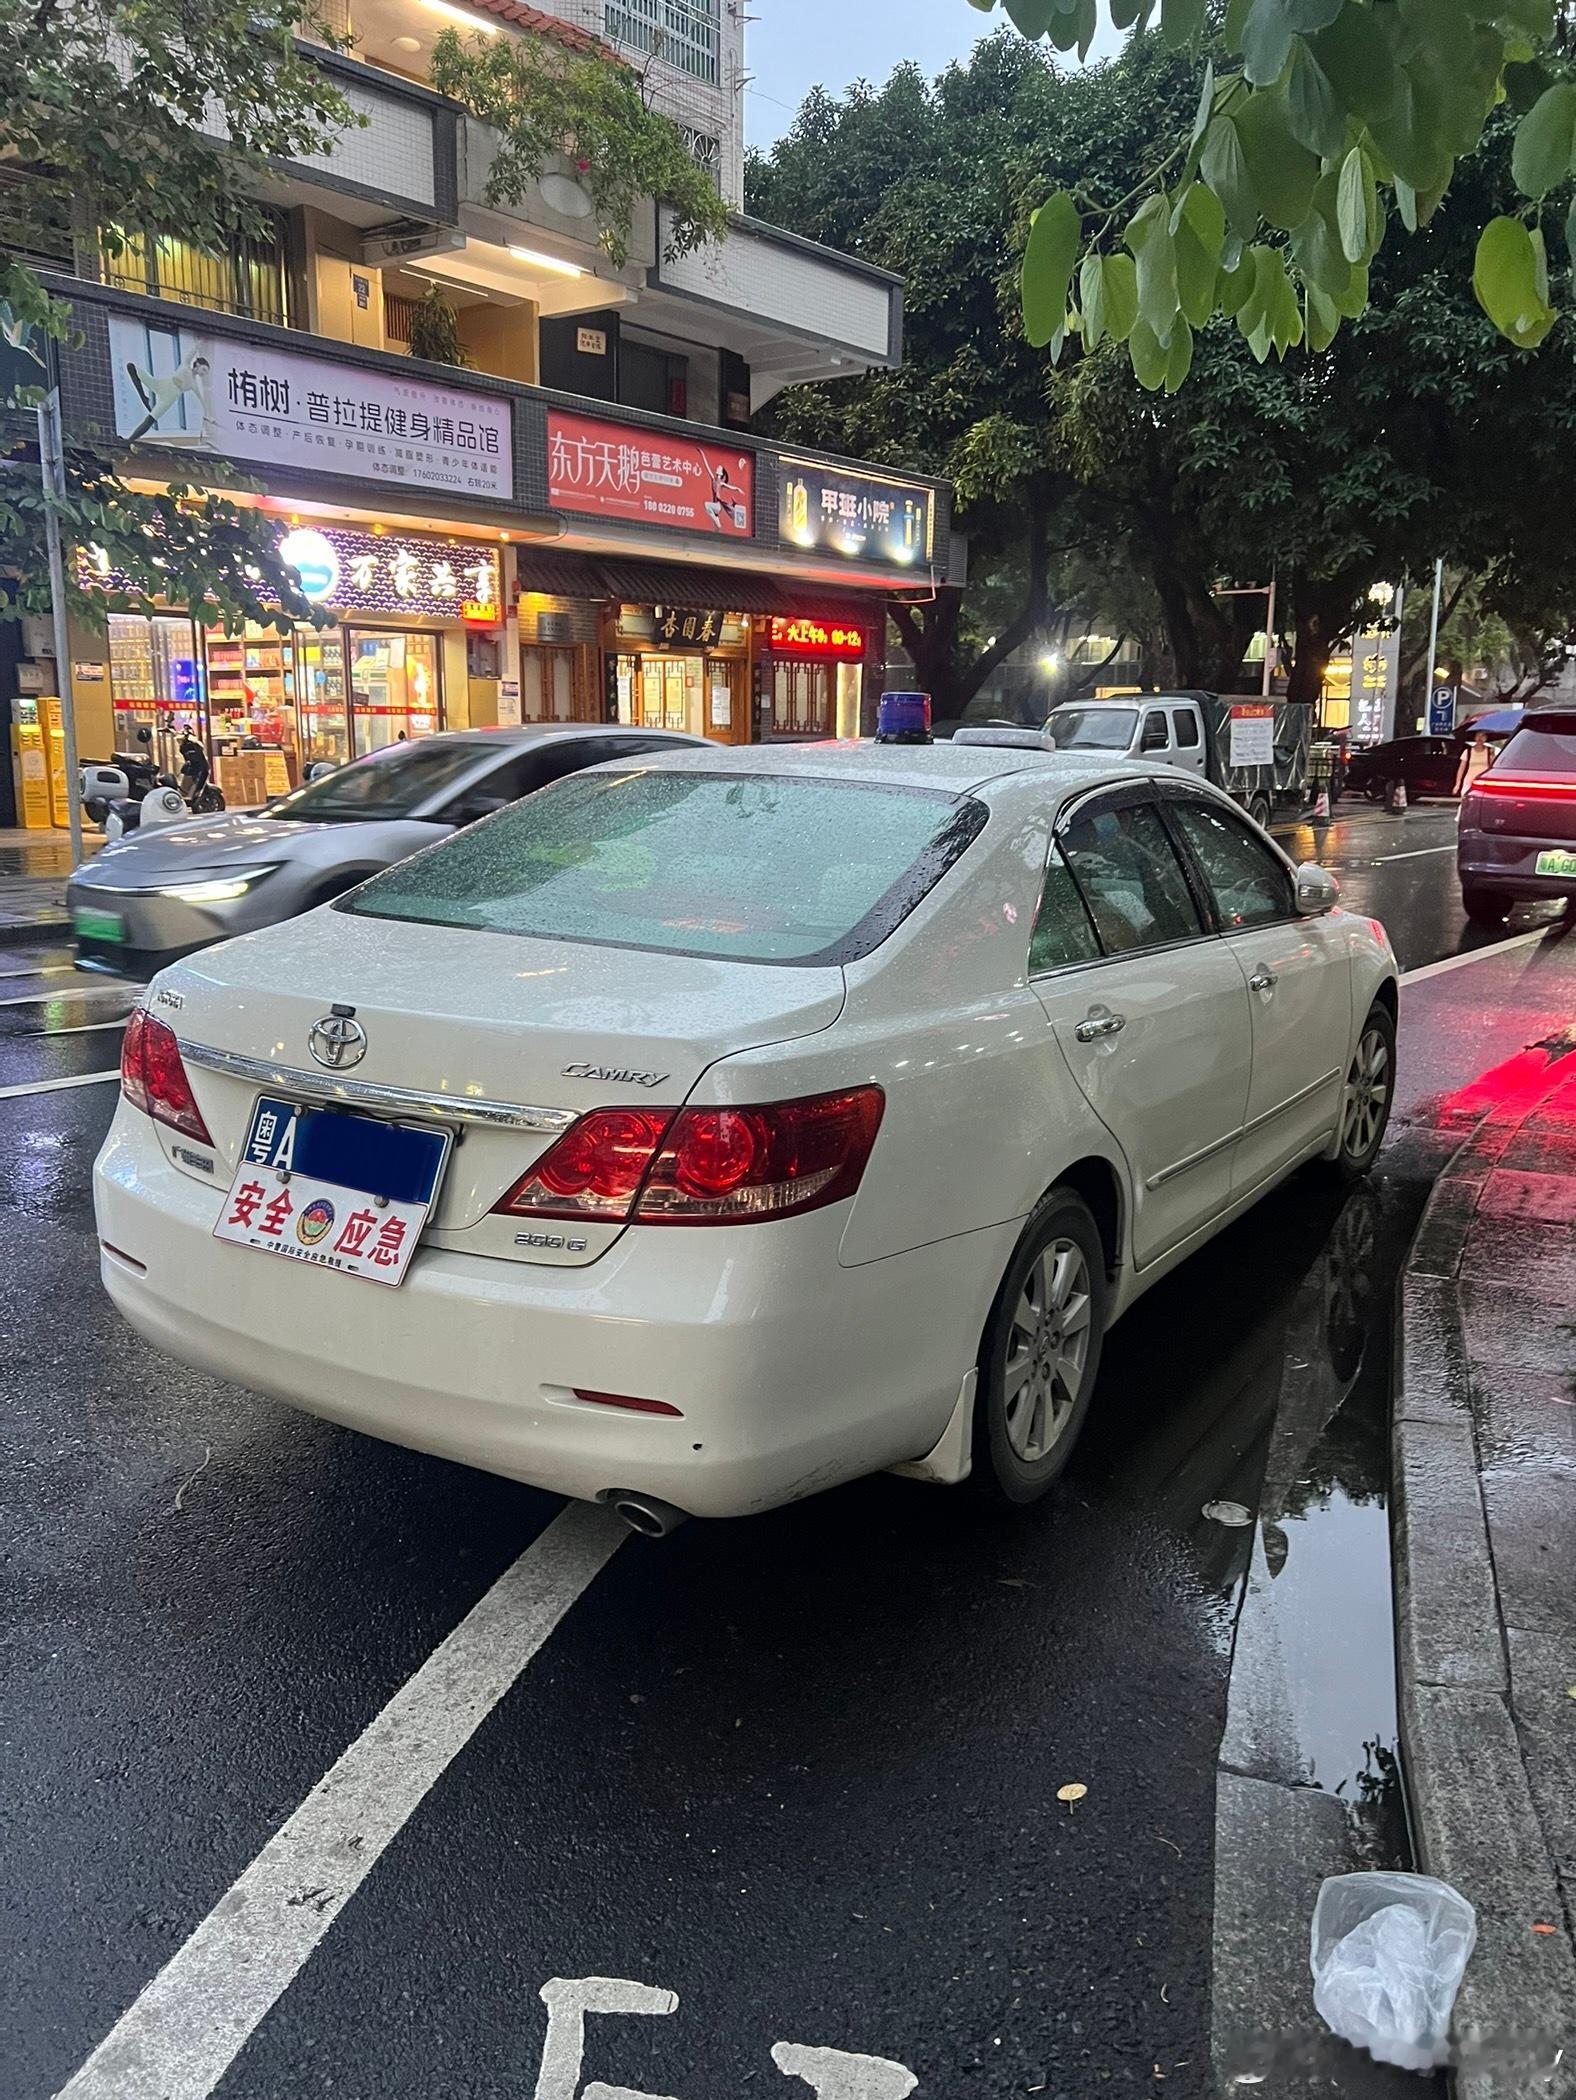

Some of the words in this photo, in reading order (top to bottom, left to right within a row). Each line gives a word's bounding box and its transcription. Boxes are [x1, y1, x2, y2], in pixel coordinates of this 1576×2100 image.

[550, 430, 641, 494] 东方天鹅
[641, 451, 703, 477] 芭蕾艺术中心
[1437, 690, 1450, 706] P
[561, 1062, 670, 1087] CAMRY
[251, 1110, 297, 1170] 粤A
[228, 1180, 294, 1236] 安全
[333, 1208, 407, 1266] 应急
[514, 1231, 565, 1248] 200
